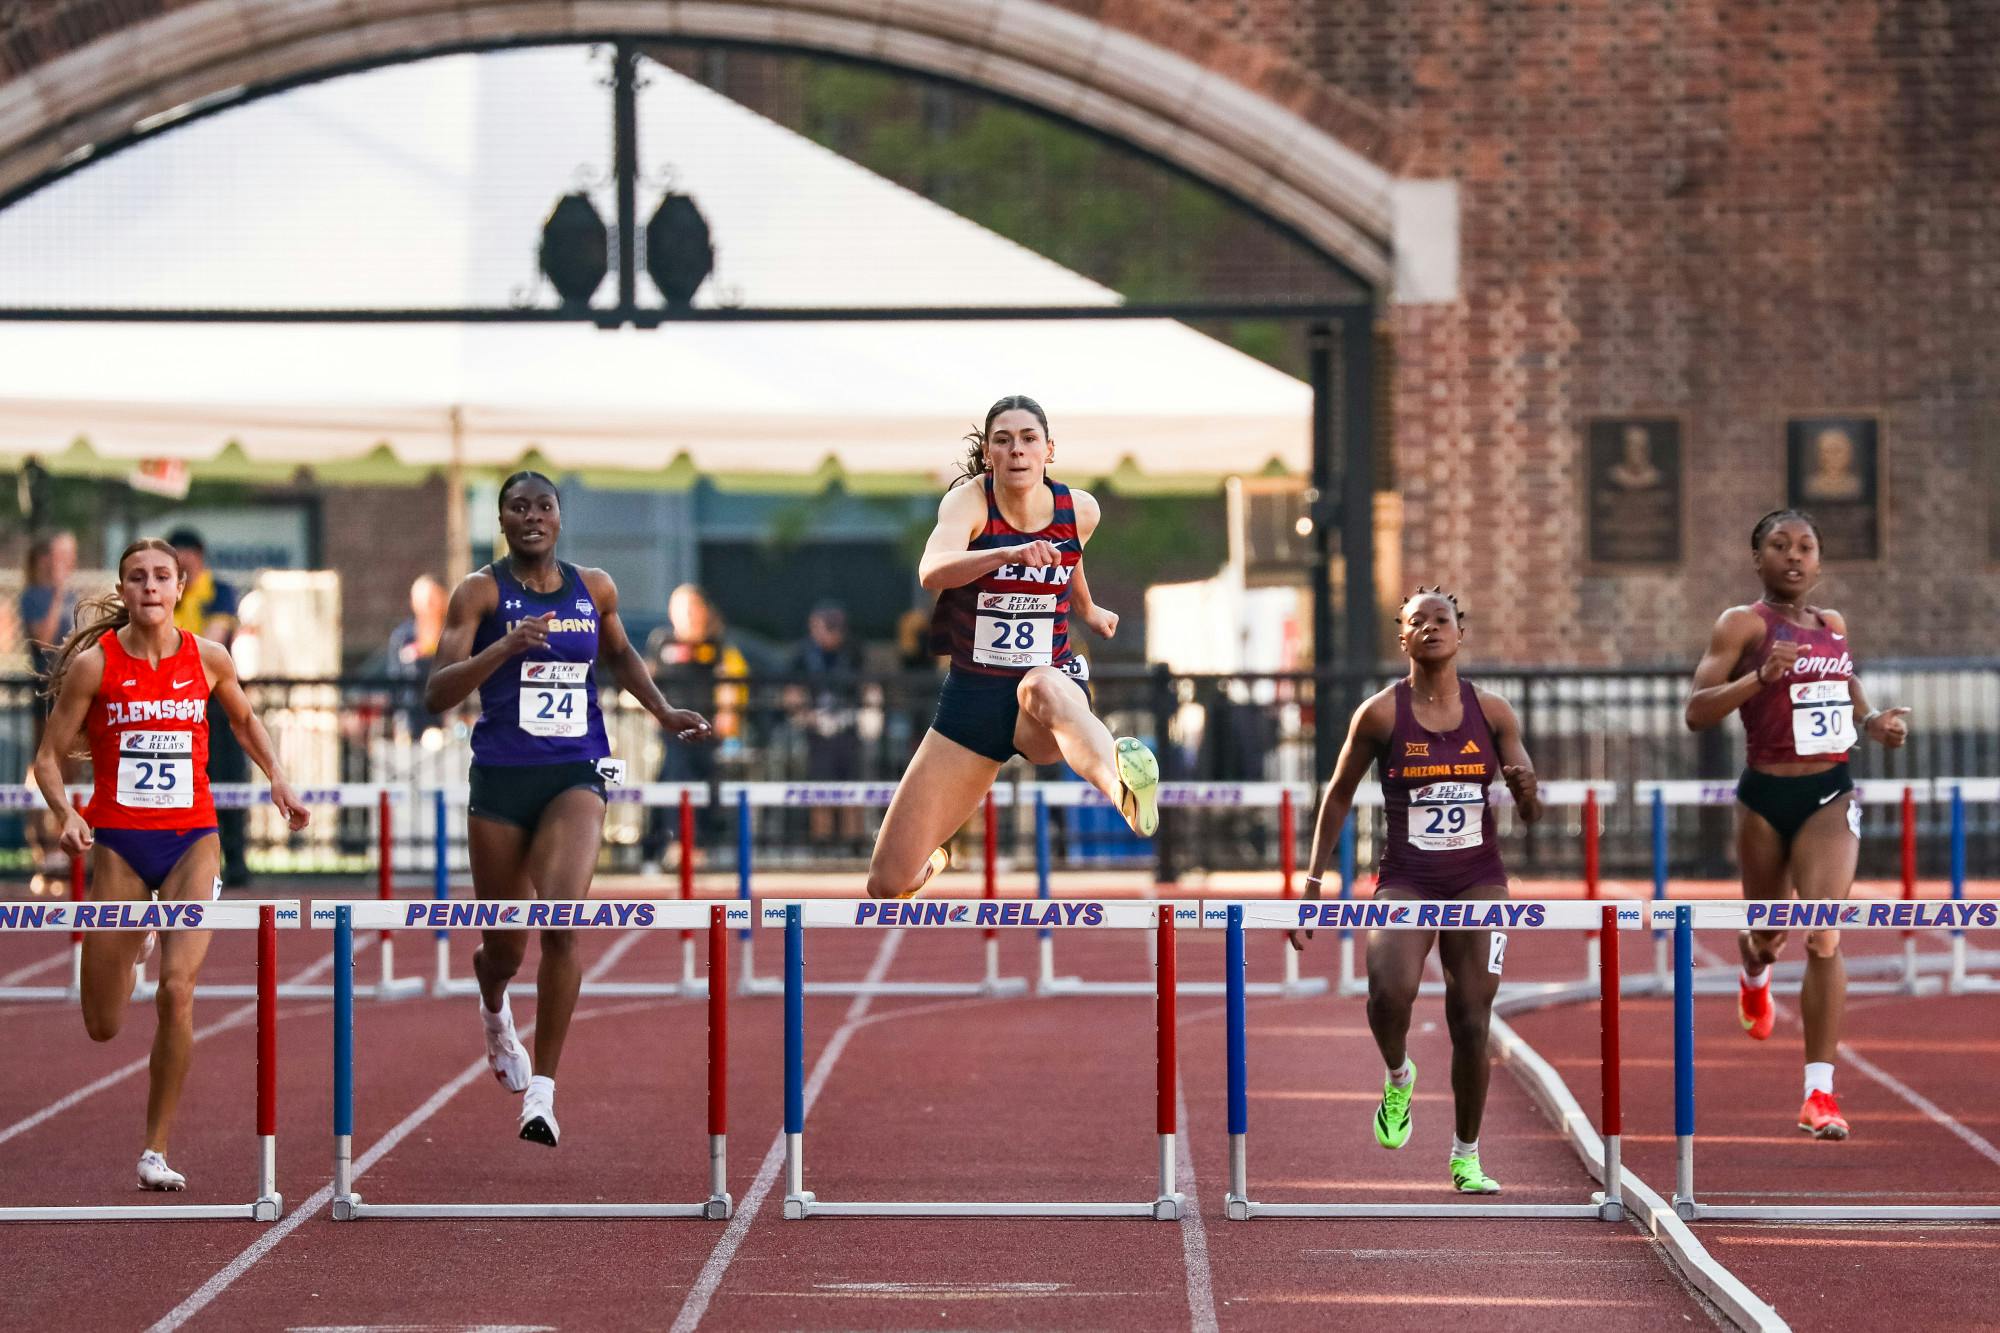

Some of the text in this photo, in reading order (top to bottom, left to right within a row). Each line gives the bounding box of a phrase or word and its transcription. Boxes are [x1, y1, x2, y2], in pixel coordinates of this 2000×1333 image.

[993, 562, 1075, 585] ENN
[992, 621, 1034, 650] 28
[1785, 651, 1854, 679] emple
[537, 691, 573, 719] 24
[1810, 709, 1842, 737] 30
[149, 742, 185, 750] RELAYS
[150, 734, 177, 742] PENN
[134, 761, 176, 791] 25
[1403, 763, 1487, 777] ARIZONA STATE
[1425, 806, 1466, 834] 29
[0, 904, 205, 928] NN RELAYS
[405, 903, 656, 926] PENN RELAYS
[855, 902, 1104, 926] PENN RELAYS
[1298, 903, 1546, 927] PENN RELAYS
[1747, 903, 1998, 927] PENN RELAYS
